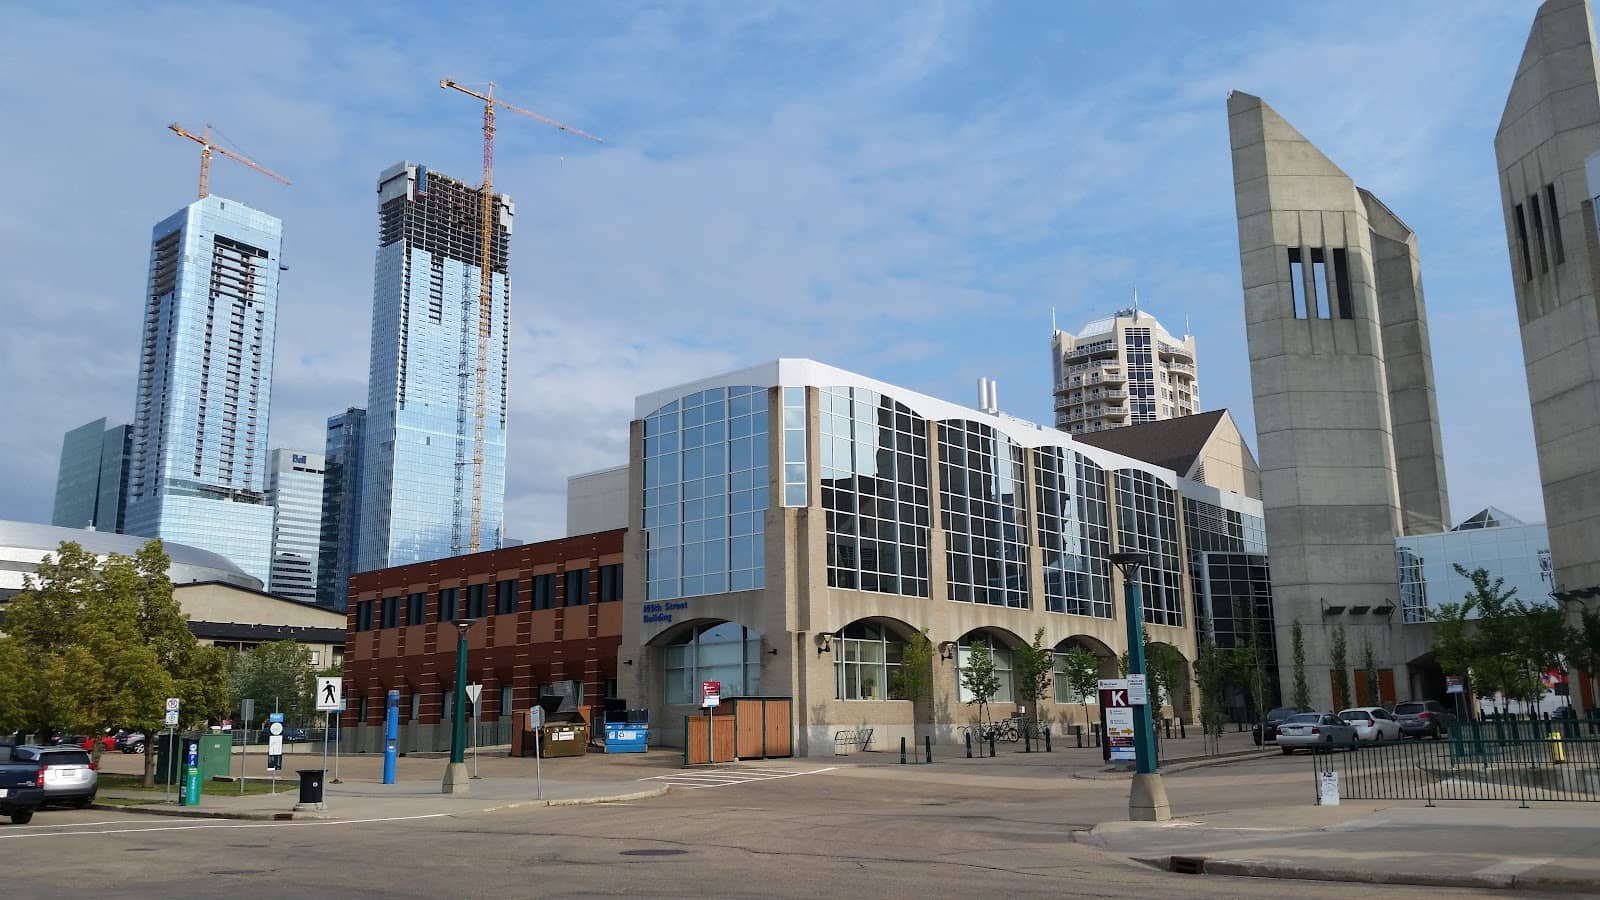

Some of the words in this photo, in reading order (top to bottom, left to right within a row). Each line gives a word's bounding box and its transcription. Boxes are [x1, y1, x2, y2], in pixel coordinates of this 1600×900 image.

[293, 454, 306, 464] Bell
[665, 601, 688, 610] Street
[643, 613, 672, 623] Building
[1111, 690, 1126, 706] K
